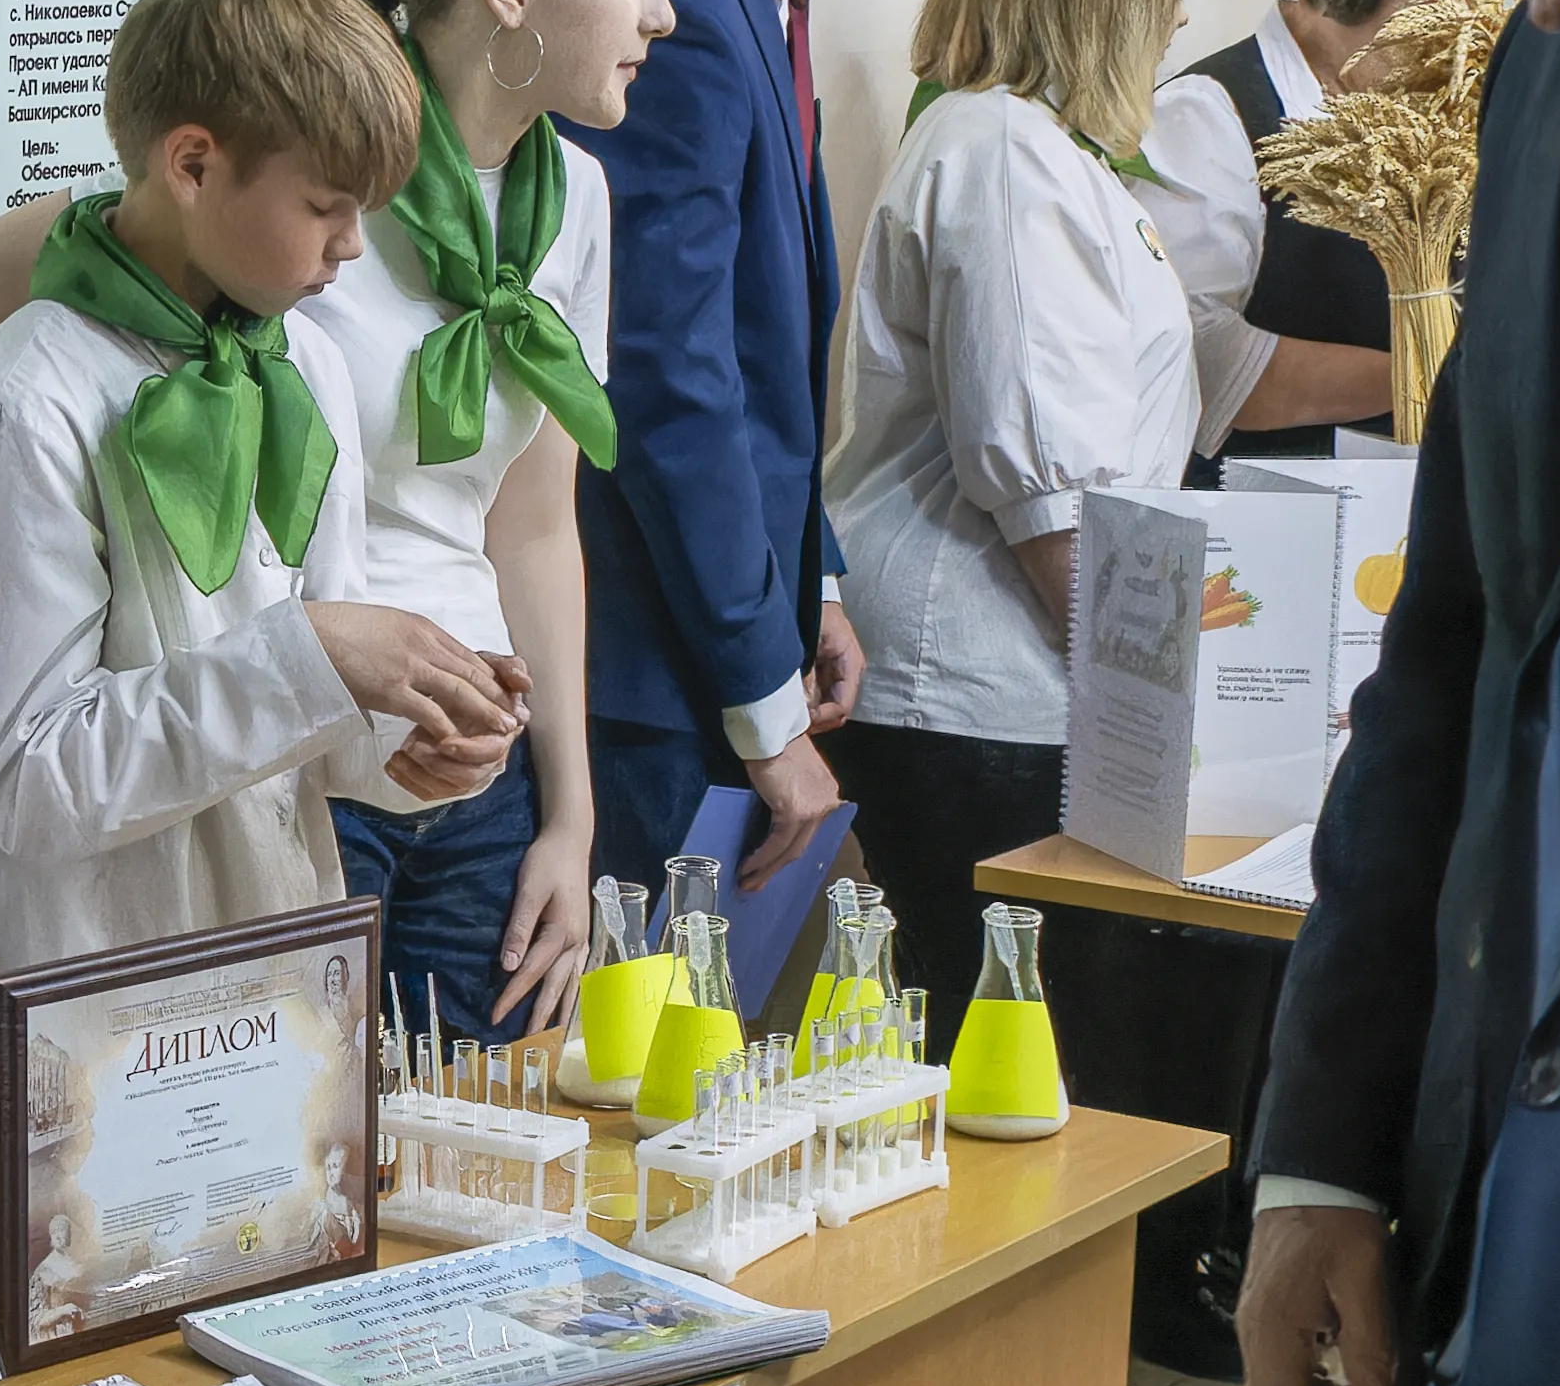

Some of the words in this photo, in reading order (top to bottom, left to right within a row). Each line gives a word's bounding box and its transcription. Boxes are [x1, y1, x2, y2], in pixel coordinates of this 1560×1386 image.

[25, 2, 113, 22] Николаевка
[9, 29, 83, 47] открылась
[9, 55, 59, 74] Проект
[42, 79, 88, 95] имени
[8, 102, 101, 123] Башкирского
[22, 139, 60, 158] Цель:
[21, 160, 106, 182] Обеспечить
[126, 1011, 277, 1082] ДИПЛОМ
